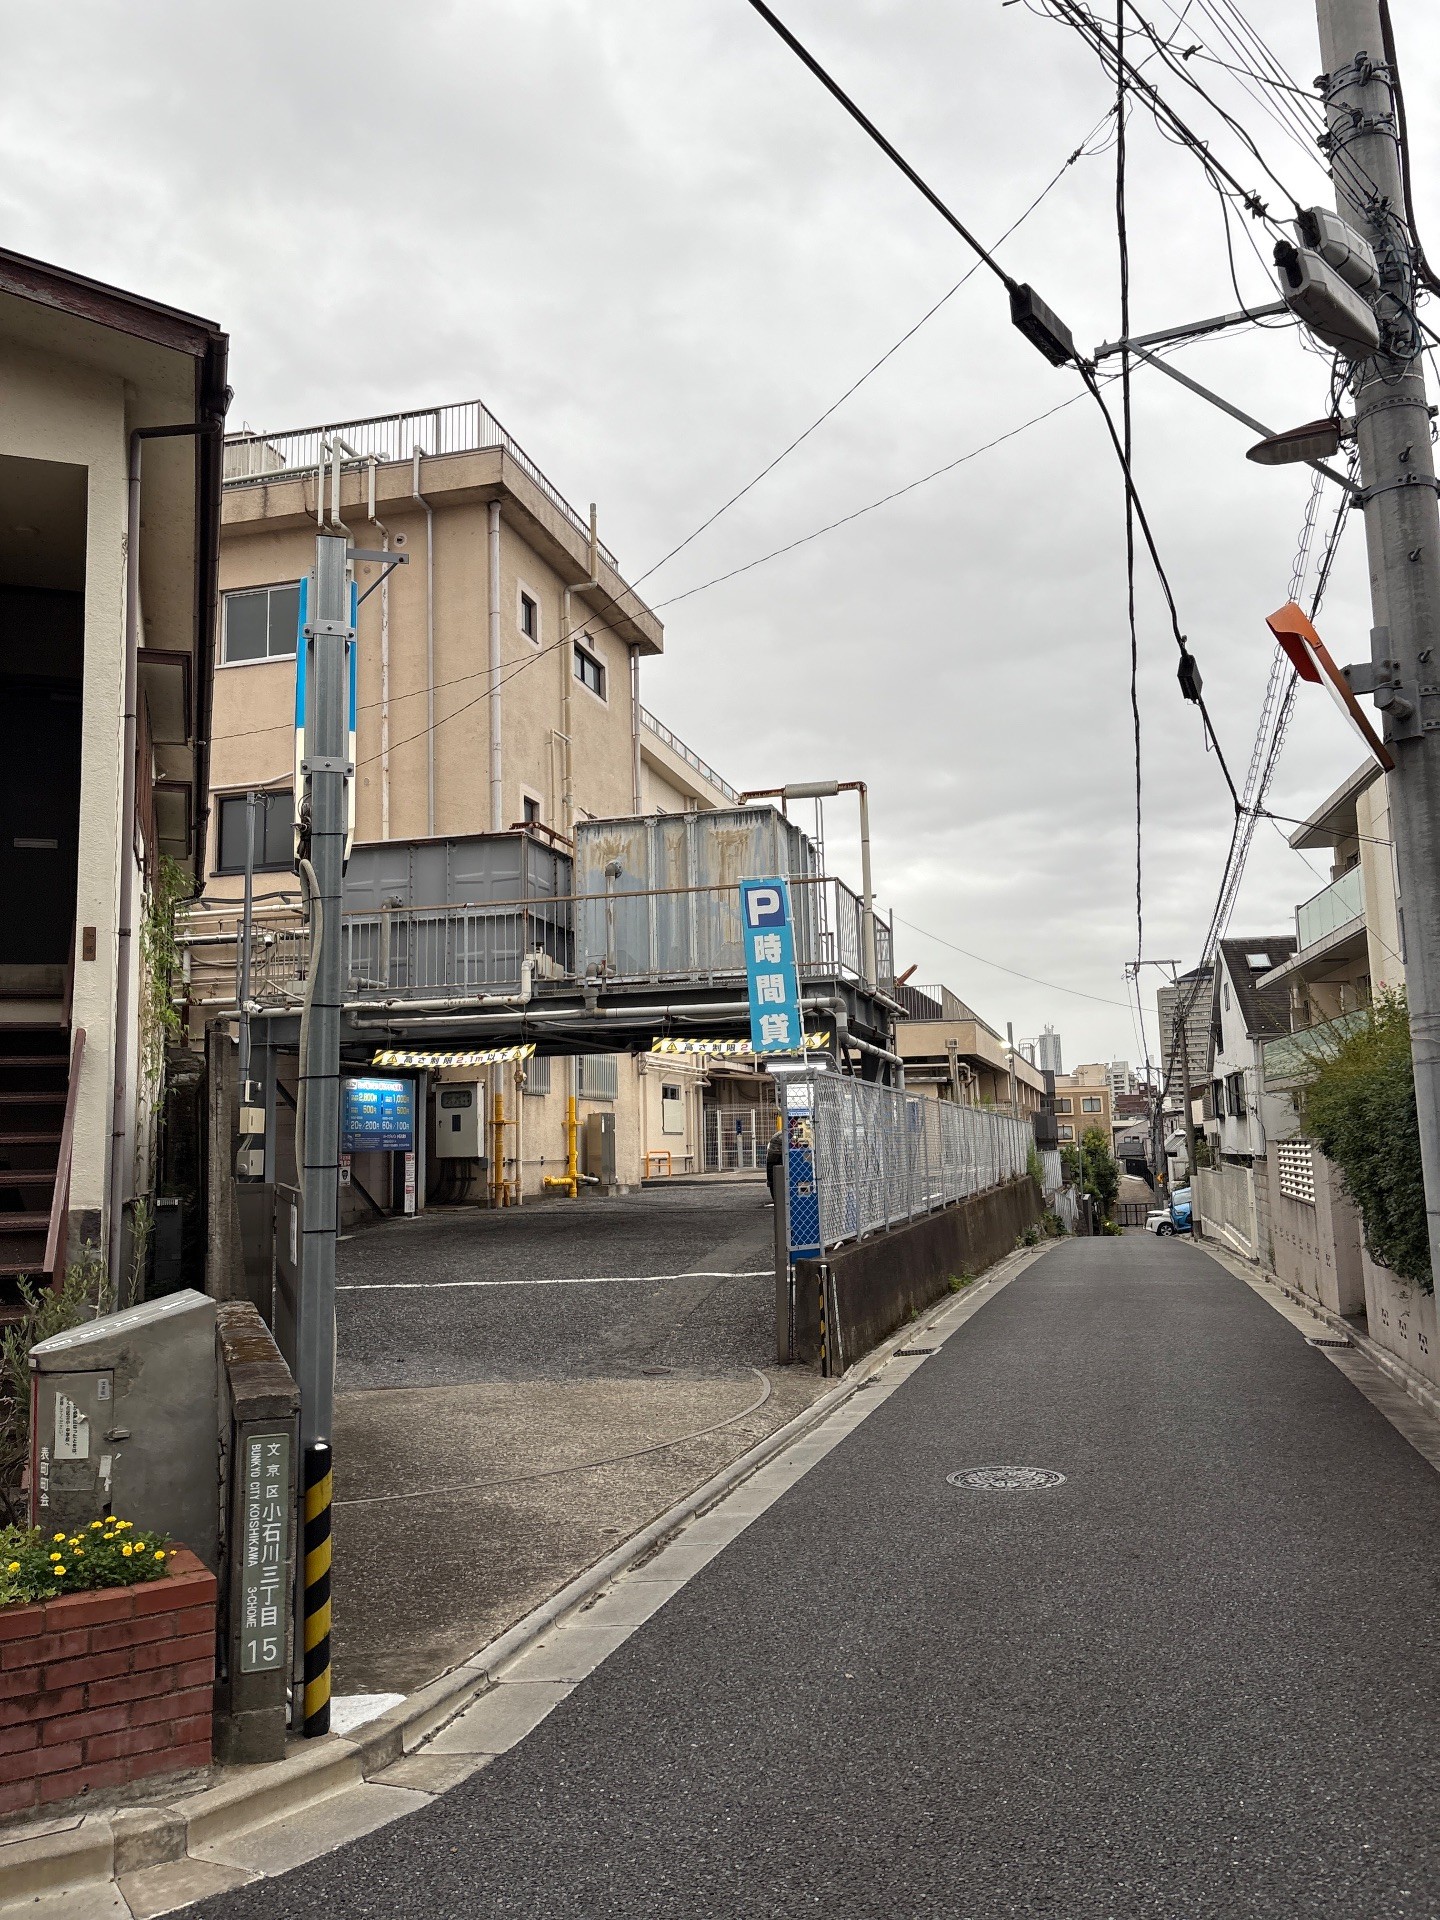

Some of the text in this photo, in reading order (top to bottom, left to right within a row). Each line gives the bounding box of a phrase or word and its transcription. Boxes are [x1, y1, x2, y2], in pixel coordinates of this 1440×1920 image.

[747, 889, 780, 926] P
[754, 933, 791, 1046] 時間貸
[684, 1042, 749, 1052] 高さ制限2
[39, 1446, 50, 1507] 表町町会
[246, 1443, 262, 1628] BUNKYO CITY KOISHIKAWA 3-CHOME
[247, 1637, 278, 1664] 15
